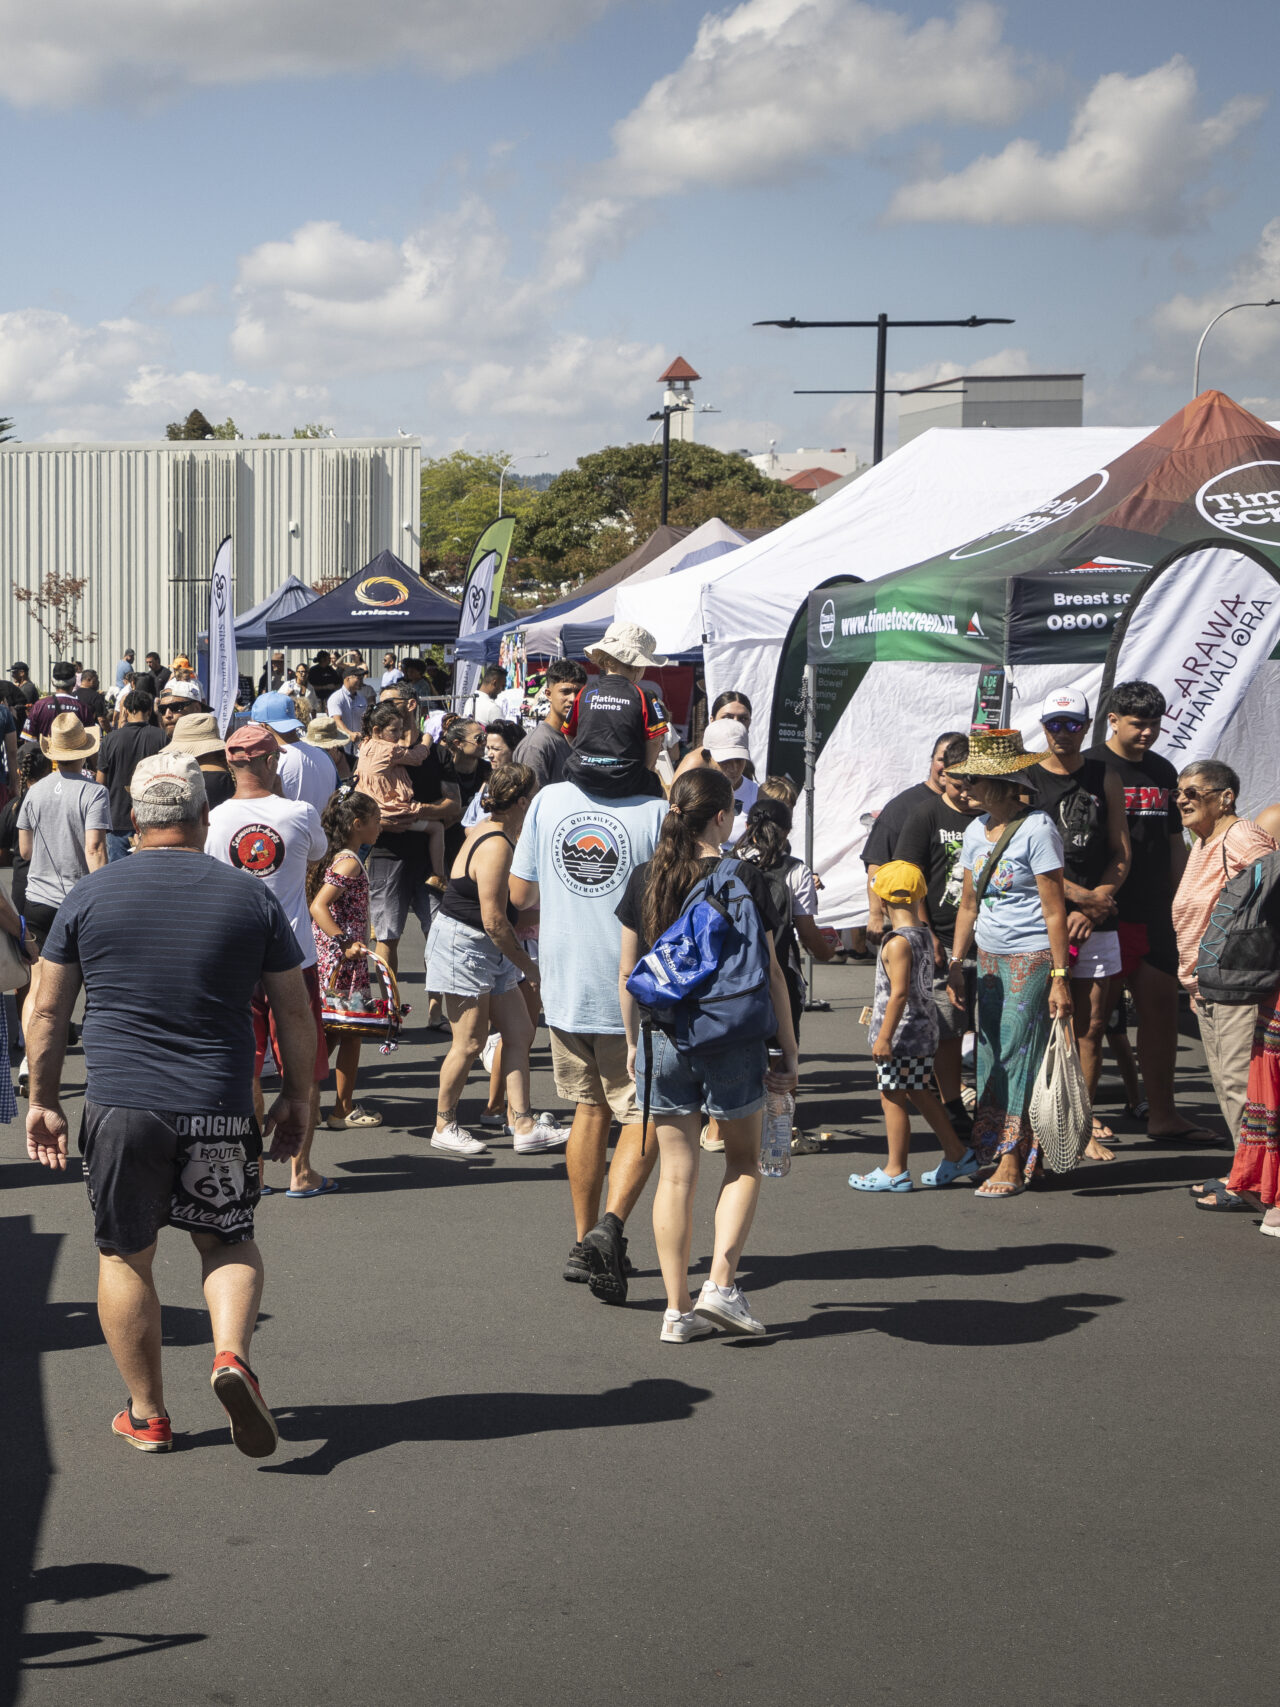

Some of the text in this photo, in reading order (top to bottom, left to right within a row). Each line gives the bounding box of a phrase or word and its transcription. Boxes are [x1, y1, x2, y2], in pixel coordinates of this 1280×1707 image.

[1053, 592, 1109, 606] Breast
[350, 608, 410, 616] unison
[841, 606, 958, 637] www.timetoscreen.nz
[1047, 613, 1108, 631] 0800
[1174, 594, 1246, 698] ARAWA
[817, 677, 843, 688] Bowel
[590, 703, 621, 711] Homes
[591, 695, 630, 705] Platinum
[1167, 650, 1238, 750] WHĀNAU
[555, 815, 626, 893] QUIKSILVER ORIGINAL BOARDRIDING COMPANY
[176, 1115, 253, 1137] ORIGINA
[200, 1147, 241, 1160] ROUTE
